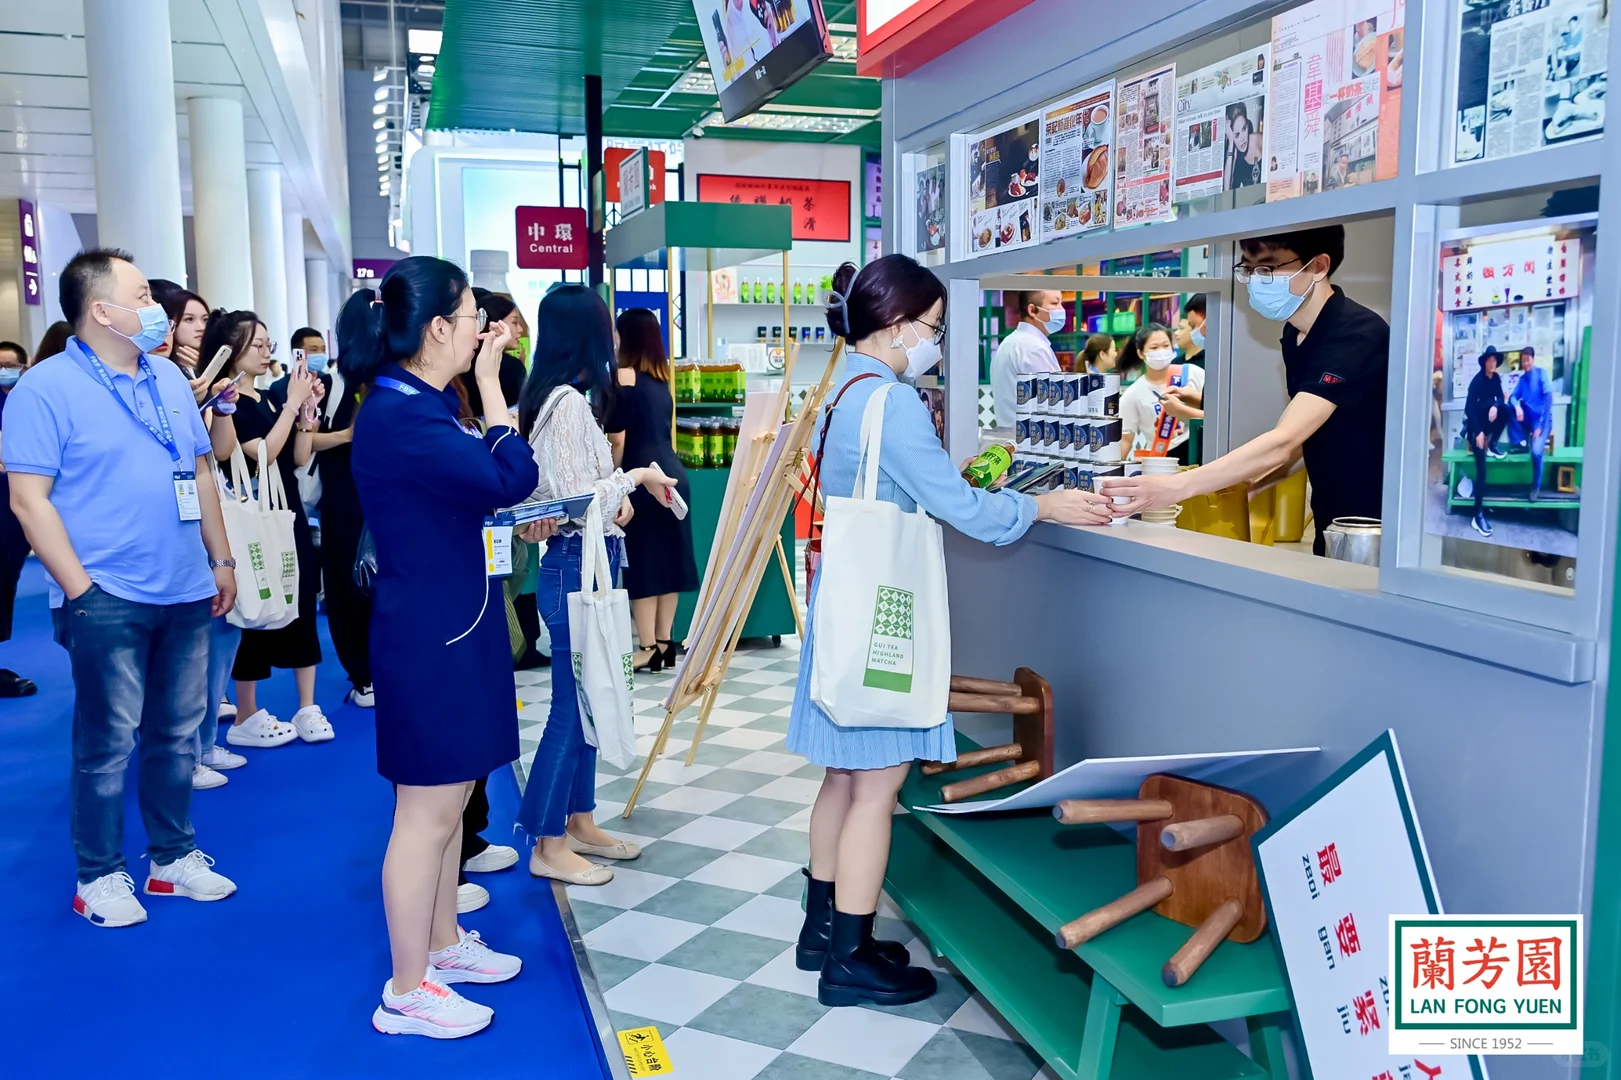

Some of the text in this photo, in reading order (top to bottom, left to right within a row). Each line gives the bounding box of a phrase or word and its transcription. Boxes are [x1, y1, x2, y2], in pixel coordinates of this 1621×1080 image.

[1177, 97, 1192, 113] City
[527, 222, 573, 241] 中環
[529, 243, 573, 253] Central
[872, 650, 904, 659] HIGHLAND
[871, 658, 897, 666] MATCHA
[1317, 926, 1336, 970] gan
[1337, 1005, 1351, 1035] jiu
